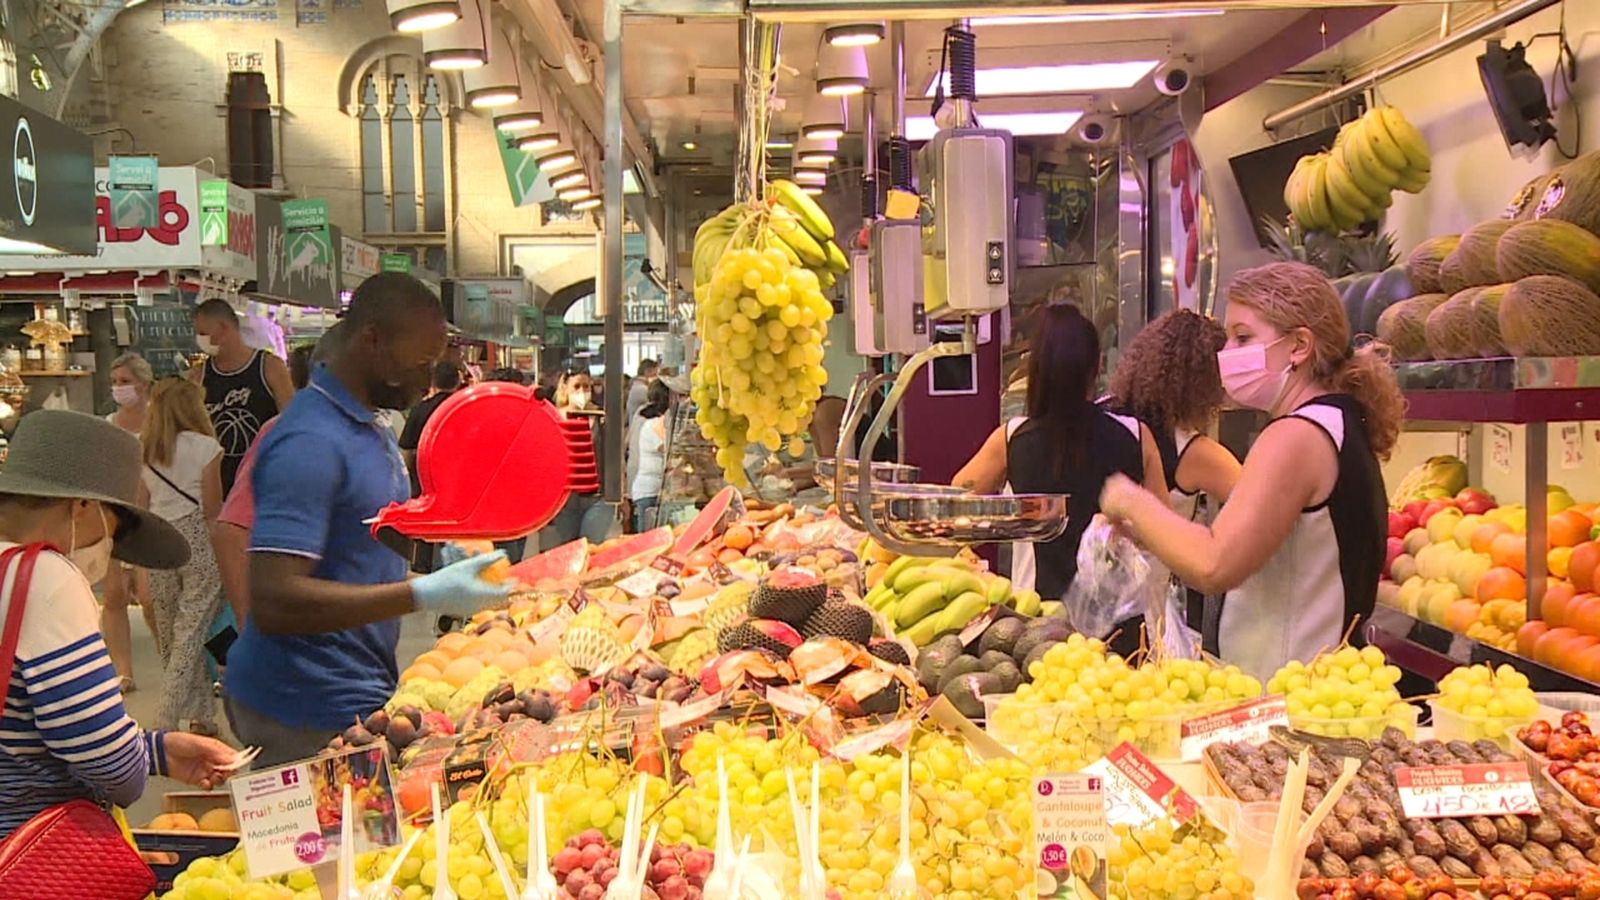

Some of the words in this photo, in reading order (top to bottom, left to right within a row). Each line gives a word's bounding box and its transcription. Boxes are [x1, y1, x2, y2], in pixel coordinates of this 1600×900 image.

[284, 206, 319, 216] Servicio
[286, 215, 325, 225] domicilio
[241, 805, 273, 822] Fruit
[278, 795, 313, 813] Salad
[1037, 801, 1104, 813] Cantaloupe
[1056, 817, 1104, 827] Coconut
[247, 821, 299, 841] Macedonia
[1037, 831, 1067, 842] Melón
[1070, 832, 1078, 842] &
[1082, 831, 1105, 842] Coco
[296, 843, 316, 856] 2,00
[1042, 851, 1059, 861] 1,50
